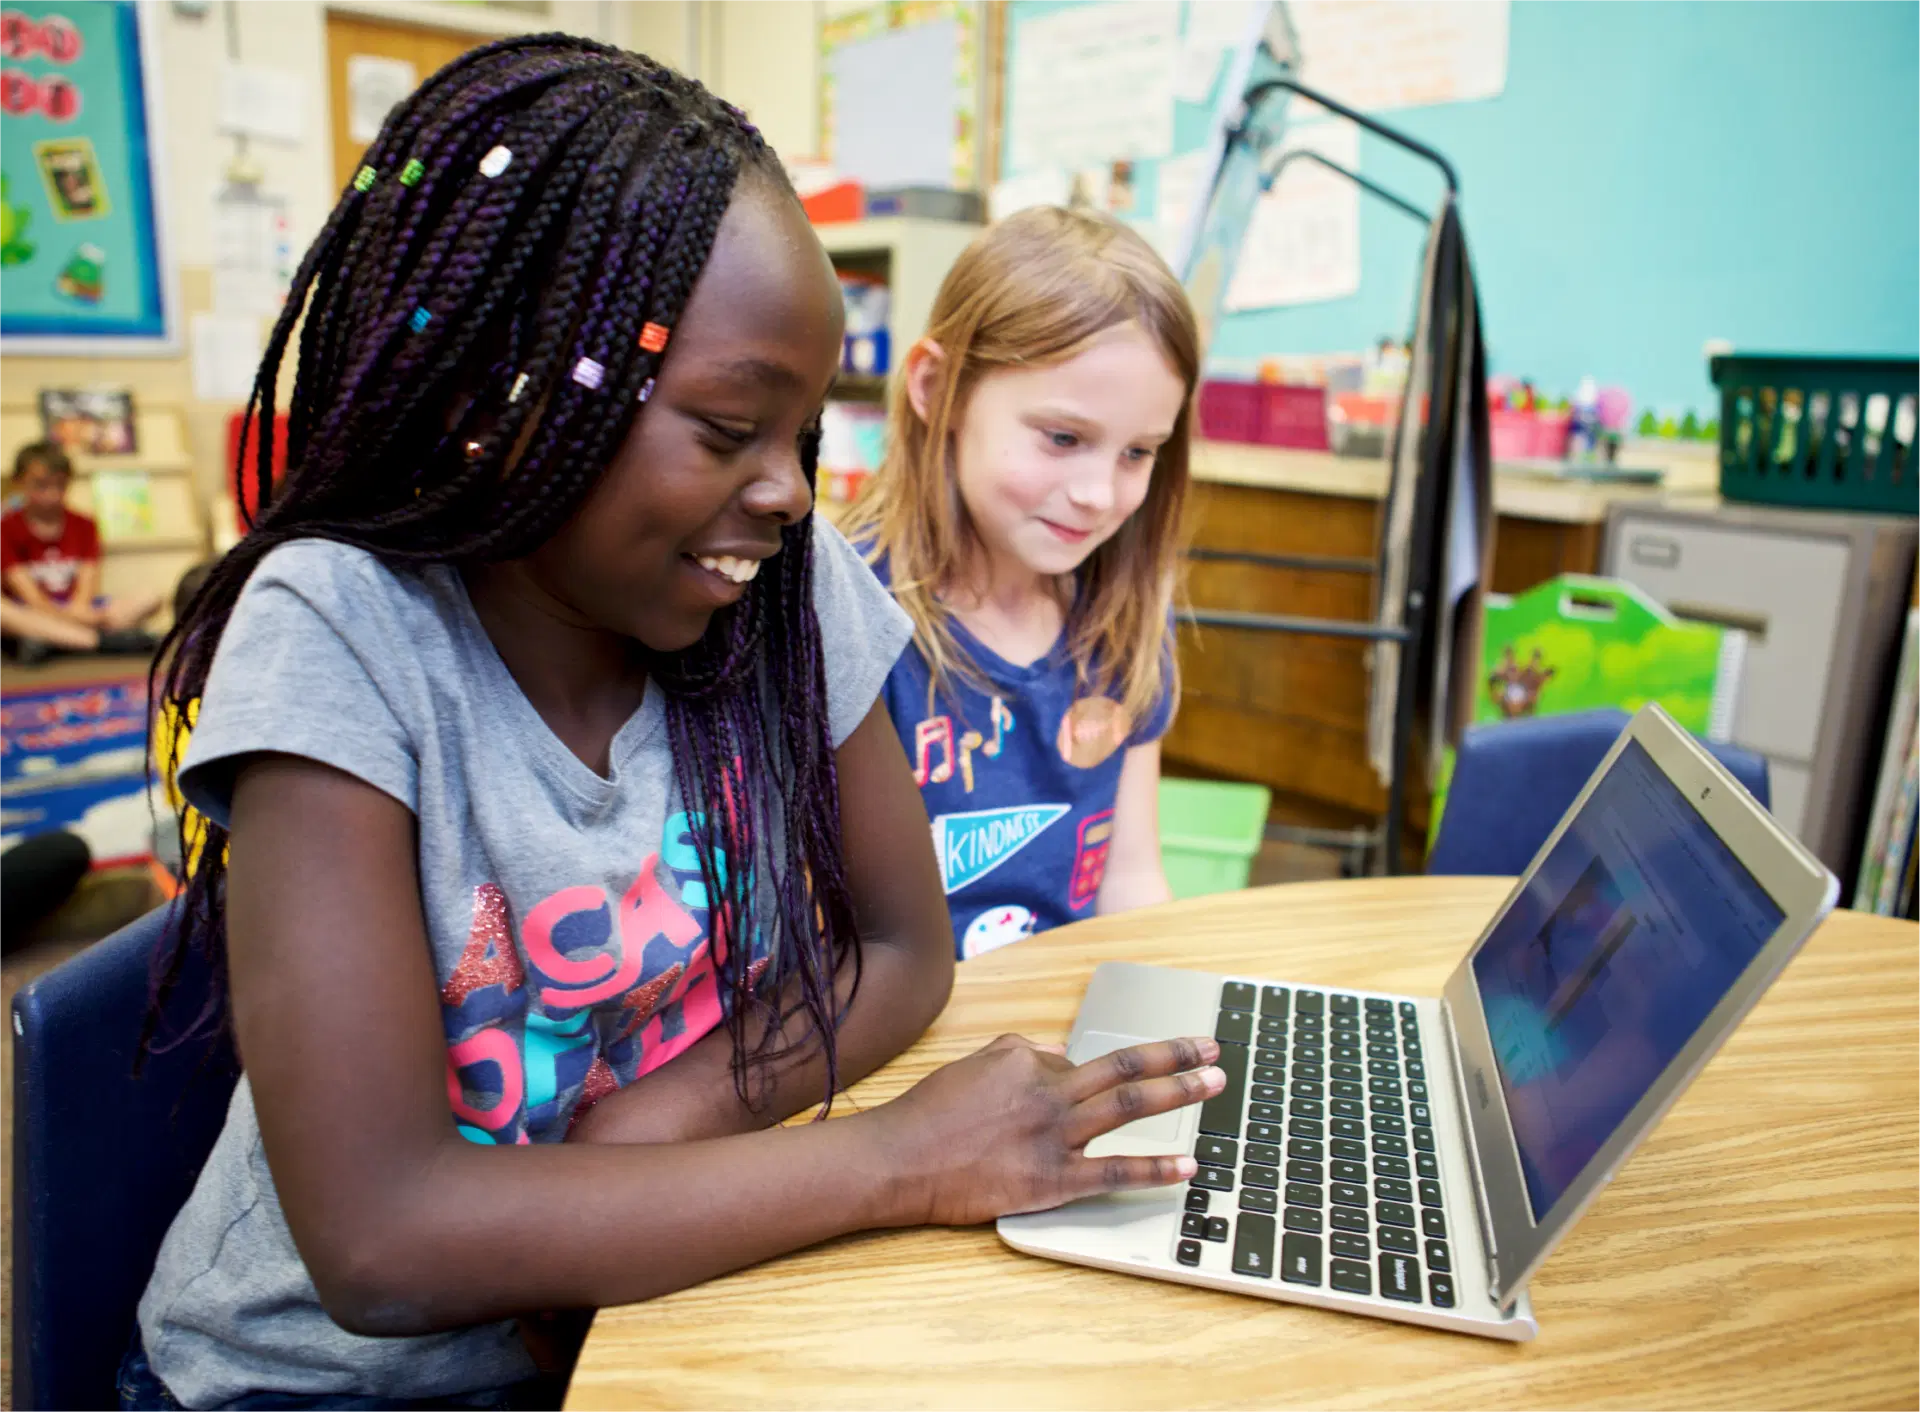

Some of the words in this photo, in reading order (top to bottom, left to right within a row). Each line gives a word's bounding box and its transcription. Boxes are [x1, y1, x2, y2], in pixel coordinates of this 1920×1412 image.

[1207, 1171, 1218, 1182] ctrl
[1247, 1251, 1261, 1268] shift
[1296, 1256, 1308, 1275] enter
[1393, 1258, 1407, 1291] backspace
